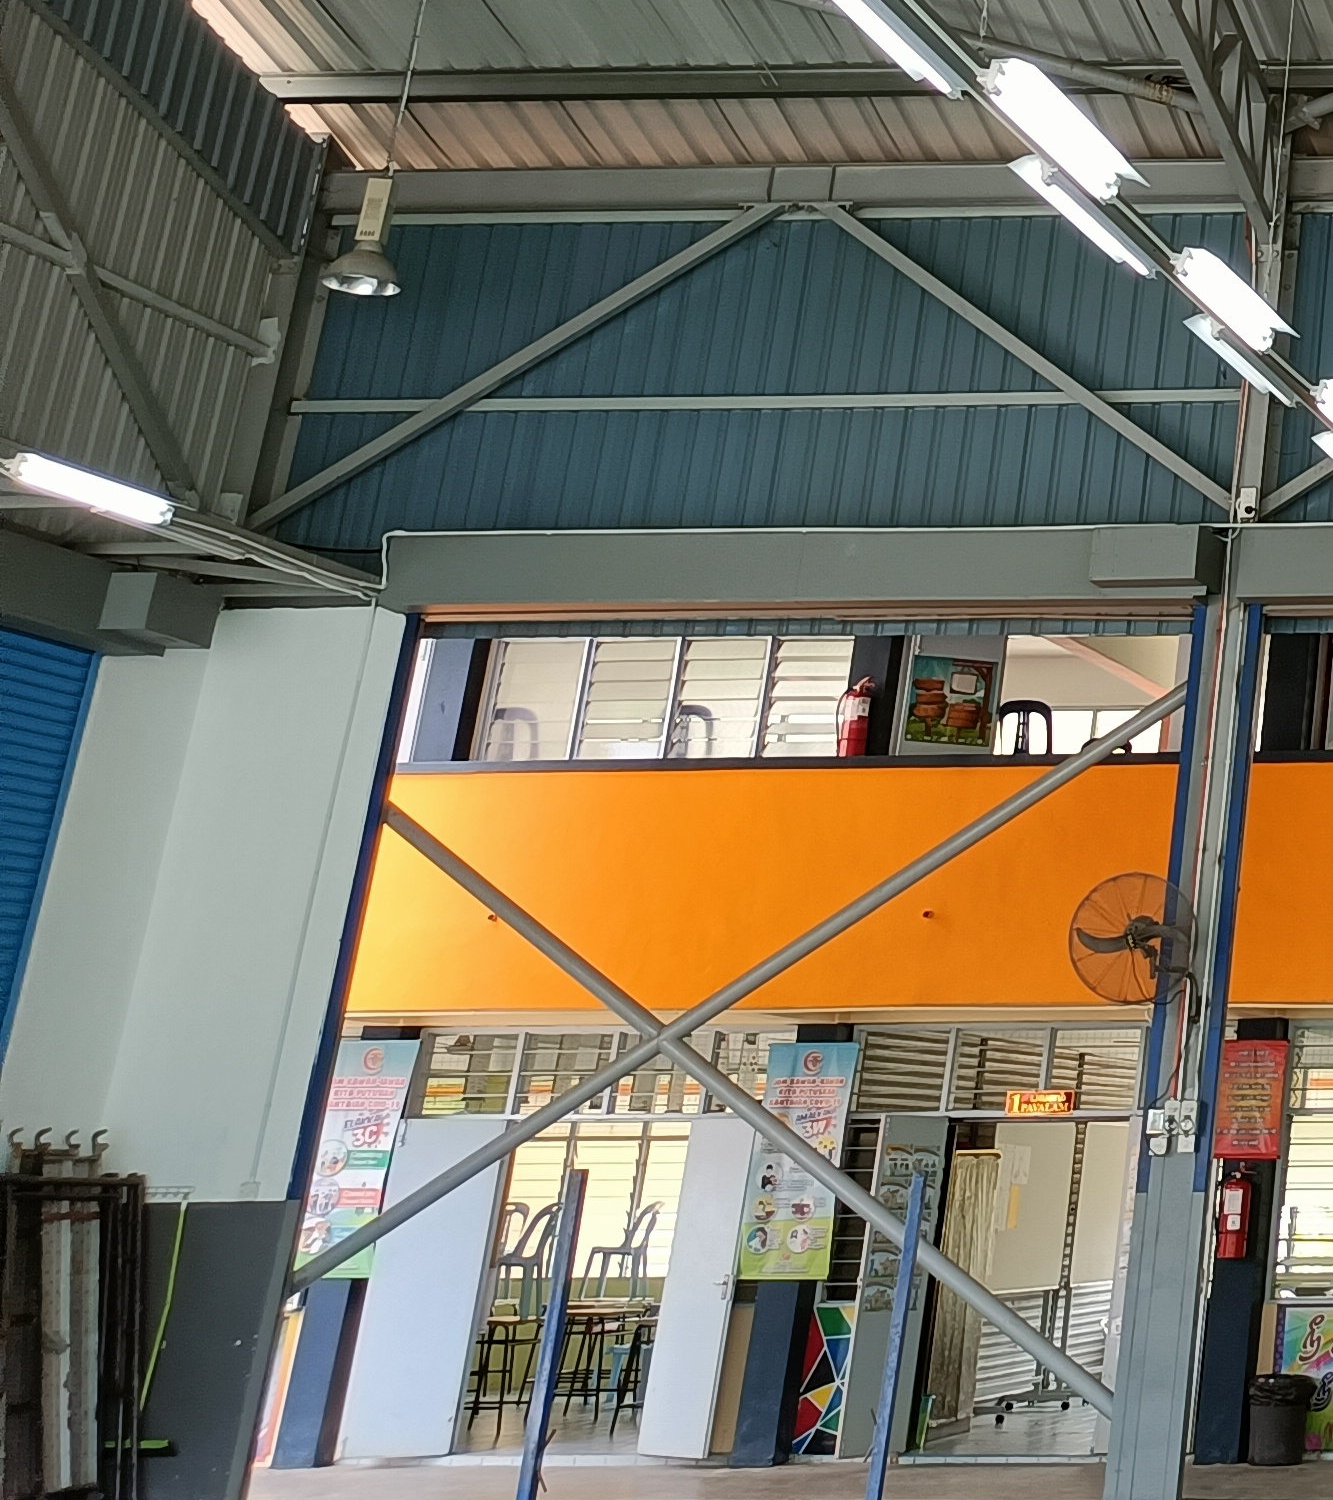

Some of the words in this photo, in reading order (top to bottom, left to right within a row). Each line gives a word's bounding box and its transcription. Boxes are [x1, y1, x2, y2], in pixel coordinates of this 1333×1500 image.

[1010, 1093, 1020, 1113] 1
[352, 1125, 379, 1147] 3C
[1299, 1314, 1326, 1363] நீ
